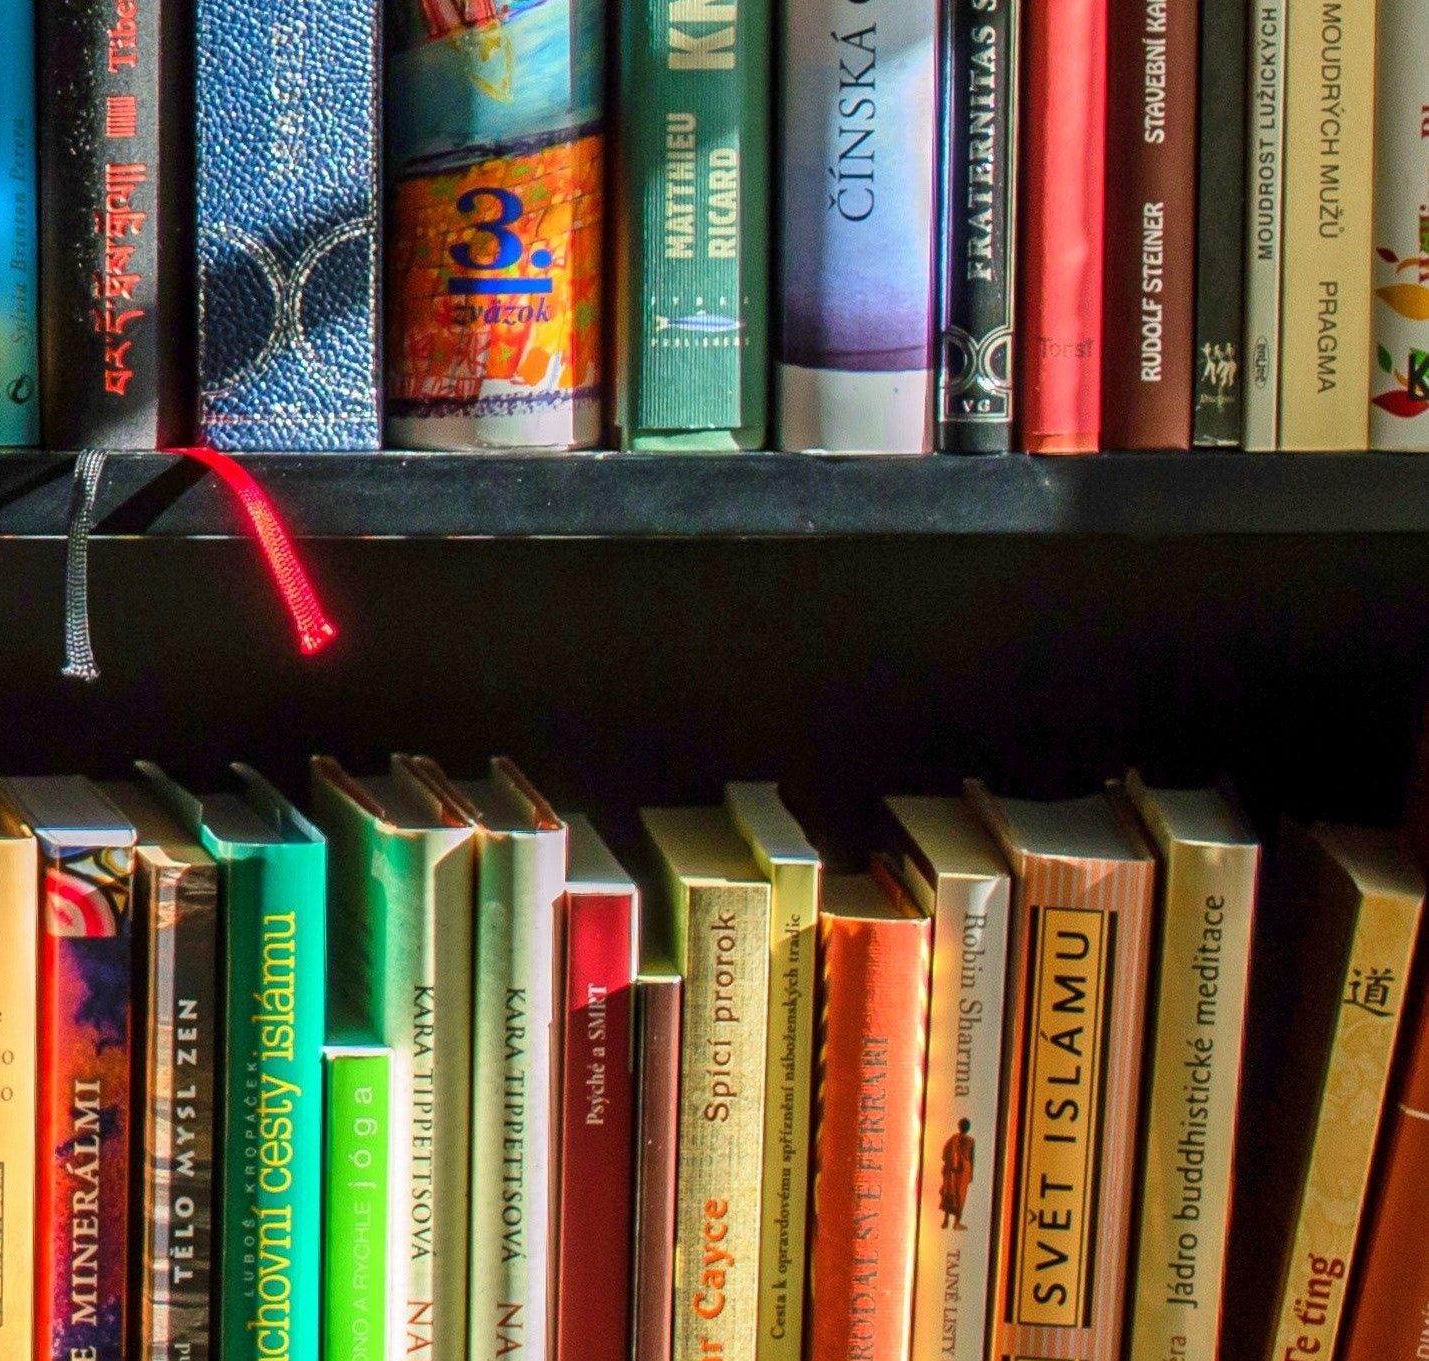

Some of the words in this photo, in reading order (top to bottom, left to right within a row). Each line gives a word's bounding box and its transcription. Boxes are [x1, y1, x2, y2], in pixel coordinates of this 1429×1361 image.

[827, 22, 877, 222] ČÍNSKÁ
[665, 112, 695, 259] MATTHIEU
[708, 147, 737, 259] RICARD
[1142, 201, 1164, 293] STEINER
[1141, 299, 1163, 381] RUDOLF
[1315, 280, 1338, 394] PRAGMA
[711, 913, 740, 1023] prorok
[961, 913, 988, 989] Robin
[1191, 895, 1225, 1027] meditace
[1343, 966, 1396, 1017] 道
[177, 999, 197, 1066] ZEN
[703, 1039, 738, 1124] Spící
[954, 998, 983, 1098] Sharma
[1039, 930, 1089, 1144] ISLÁMU
[174, 1085, 196, 1177] MYSL
[1172, 1037, 1213, 1222] buddhistické
[169, 1196, 194, 1285] TĚLO
[1028, 1172, 1073, 1307] SVĚT
[1166, 1233, 1197, 1310] Jádro
